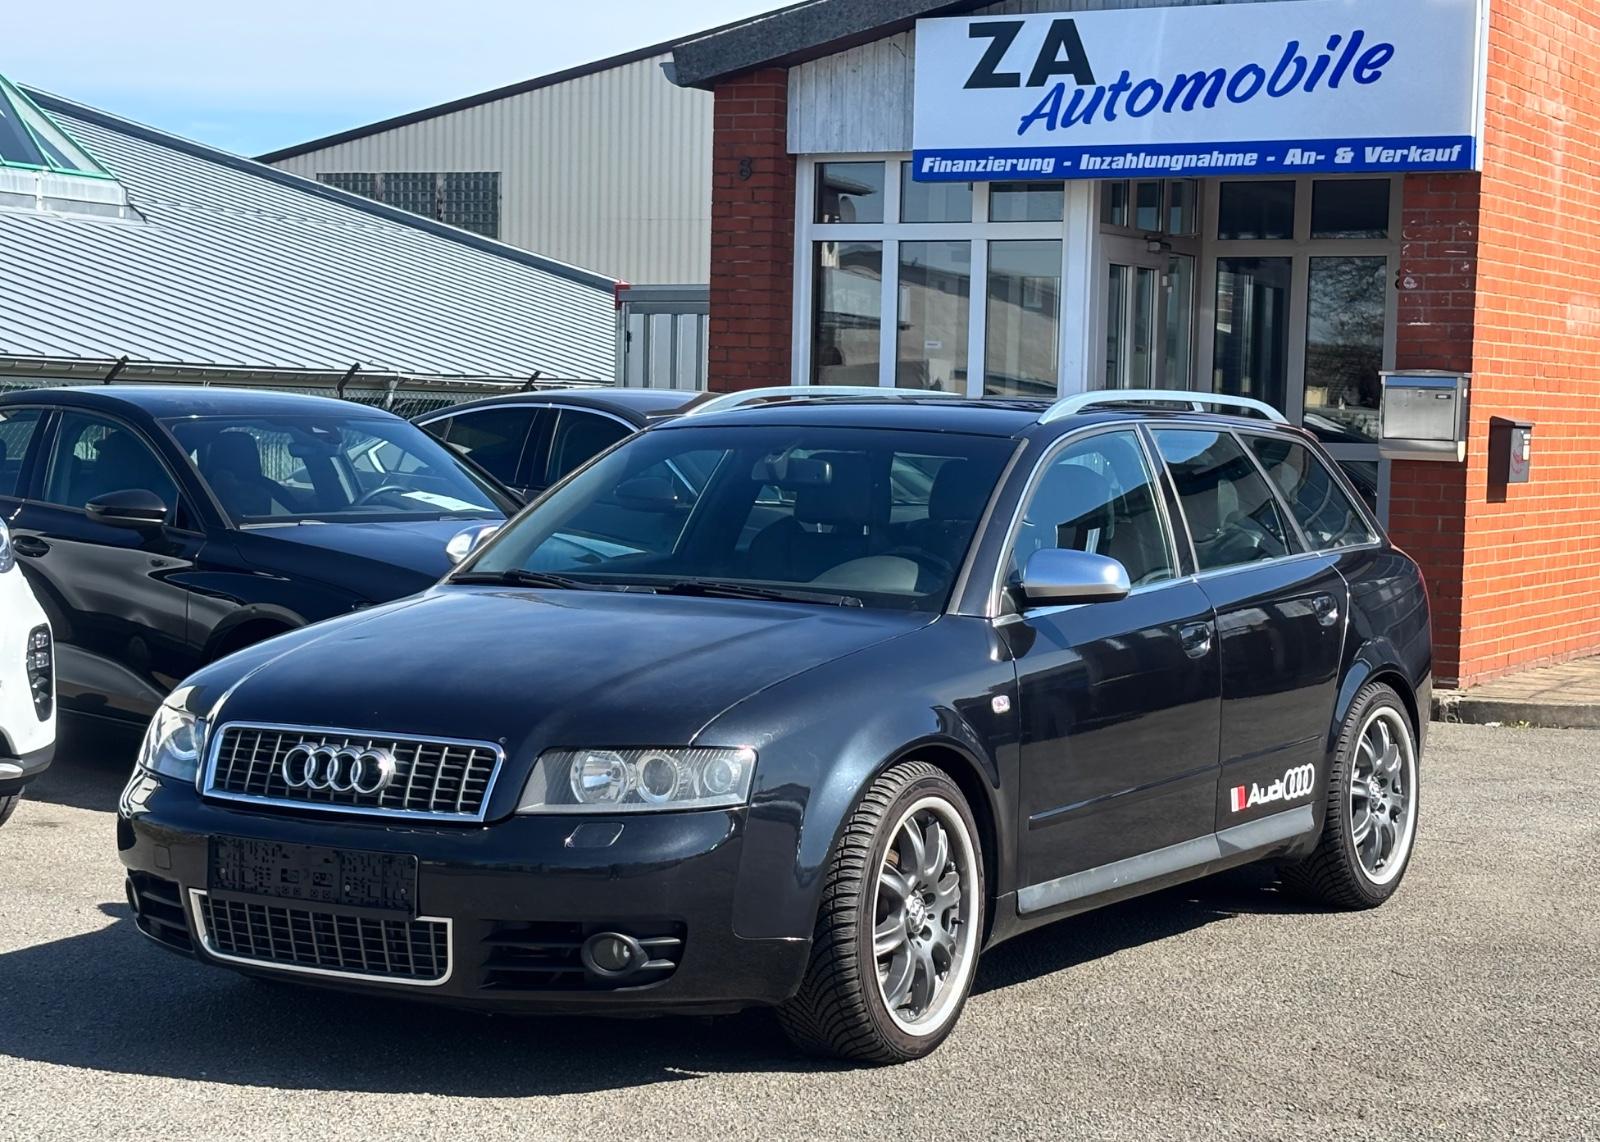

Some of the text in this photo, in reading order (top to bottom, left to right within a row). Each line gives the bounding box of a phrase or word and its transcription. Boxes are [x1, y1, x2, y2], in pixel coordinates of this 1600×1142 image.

[963, 18, 1096, 89] ZA
[1017, 30, 1395, 136] Automobile
[921, 156, 1055, 174] Finanzierung
[1079, 151, 1258, 171] Inzahlungnahme
[1283, 148, 1325, 165] An-
[1334, 147, 1354, 164] &
[1364, 145, 1462, 163] Verkauf
[1246, 779, 1284, 807] Audi
